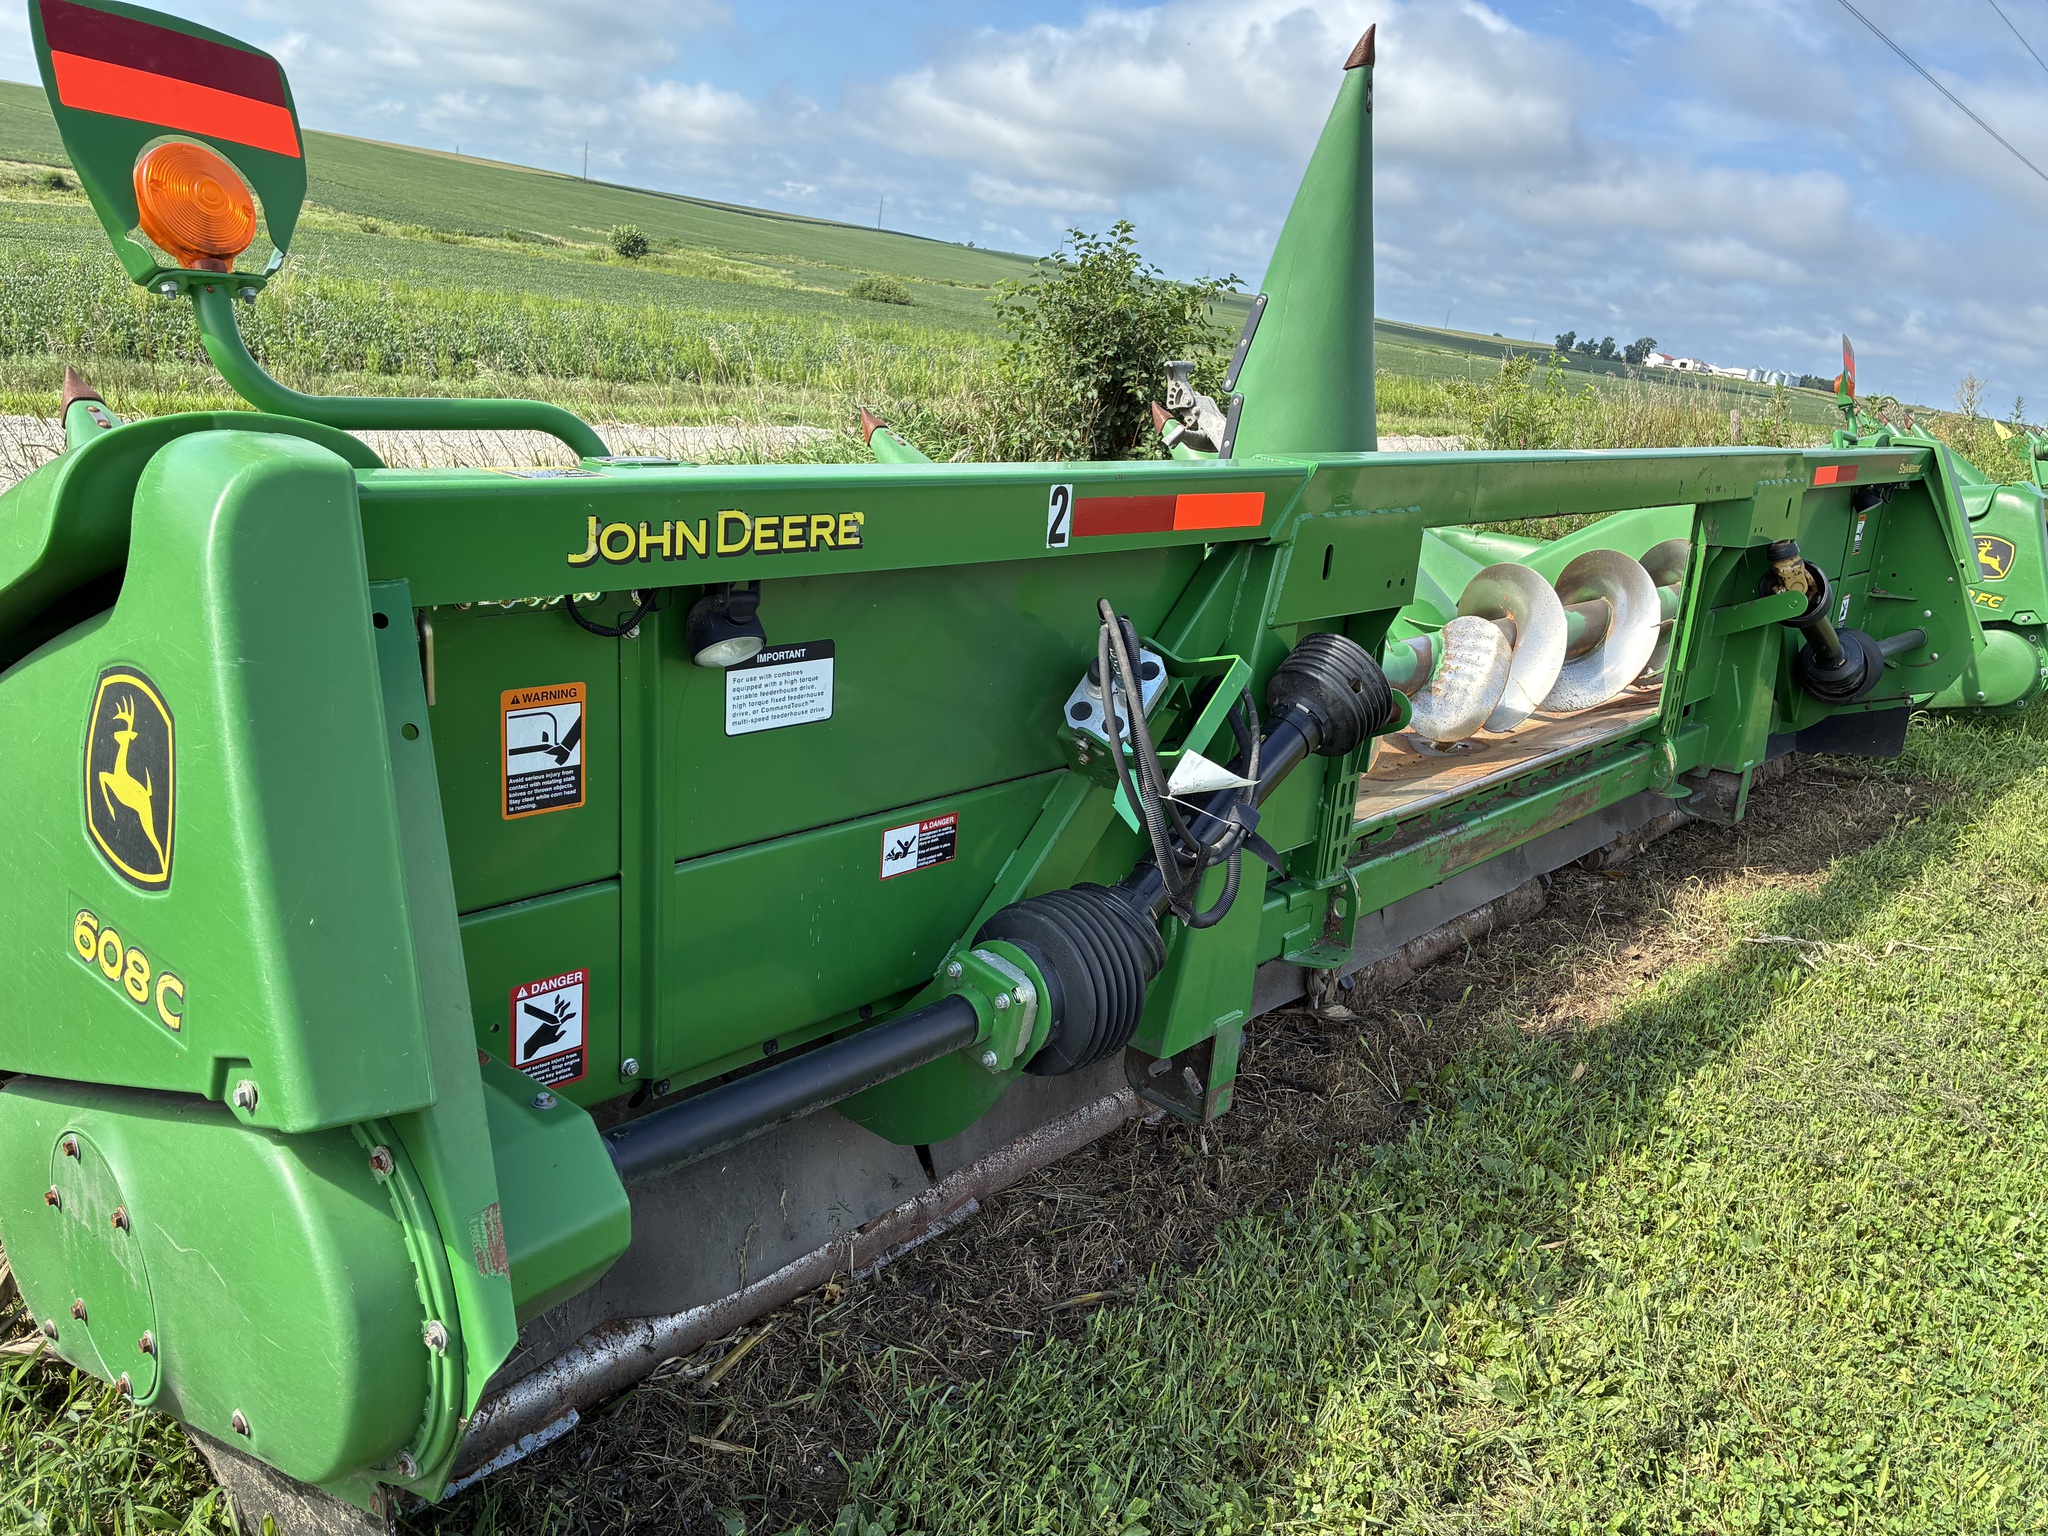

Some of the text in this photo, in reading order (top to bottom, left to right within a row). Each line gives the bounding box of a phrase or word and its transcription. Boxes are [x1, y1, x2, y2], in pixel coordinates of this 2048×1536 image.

[1048, 485, 1068, 544] 2
[567, 509, 864, 568] JOHN DEERE
[757, 649, 806, 663] IMPORTANT
[774, 669, 803, 678] combines
[732, 683, 762, 693] equipped
[732, 692, 758, 701] variable
[760, 687, 798, 696] feederhouse
[788, 691, 824, 699] feederhouse
[522, 688, 577, 703] WARNING
[732, 716, 769, 726] multi-speed
[771, 709, 808, 719] feederhouse
[929, 817, 954, 828] DANGER
[531, 971, 582, 994] DANGER
[532, 1061, 550, 1071] serious
[551, 1056, 565, 1064] injury
[556, 1067, 571, 1075] before
